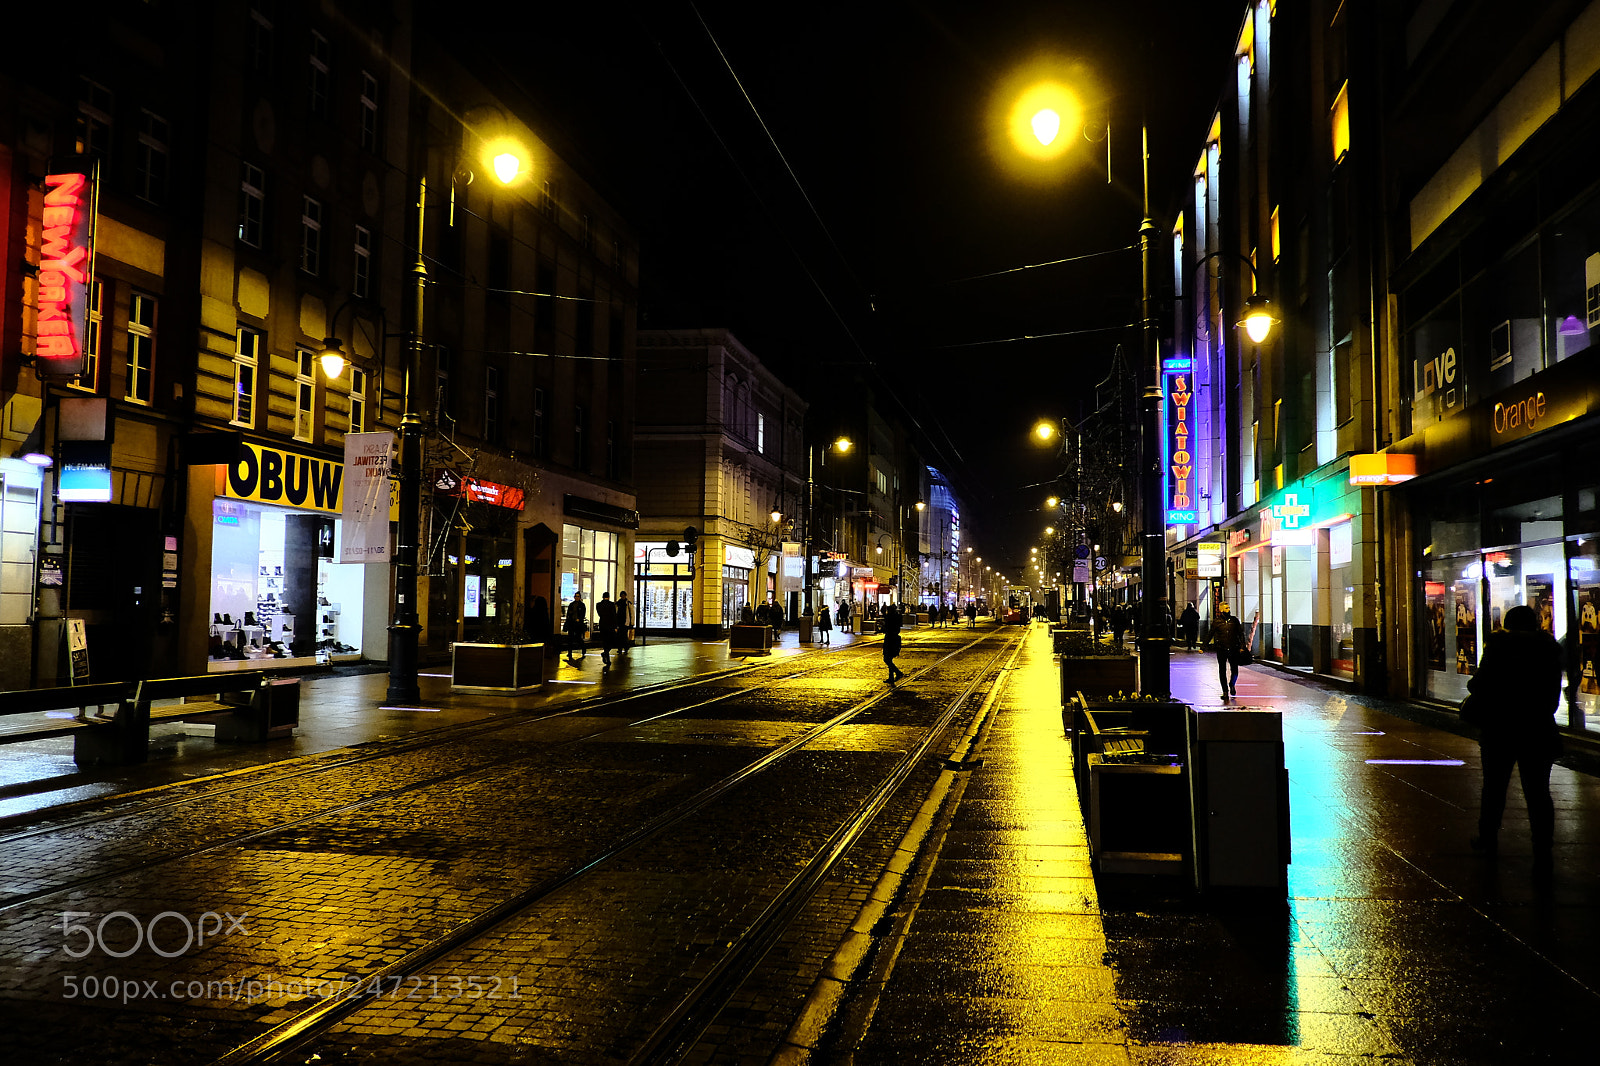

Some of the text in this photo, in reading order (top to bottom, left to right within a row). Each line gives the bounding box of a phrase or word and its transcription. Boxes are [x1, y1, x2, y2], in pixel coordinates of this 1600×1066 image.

[1493, 392, 1547, 434] Orange
[64, 462, 107, 471] HOFMANN
[1169, 512, 1195, 521] KINO
